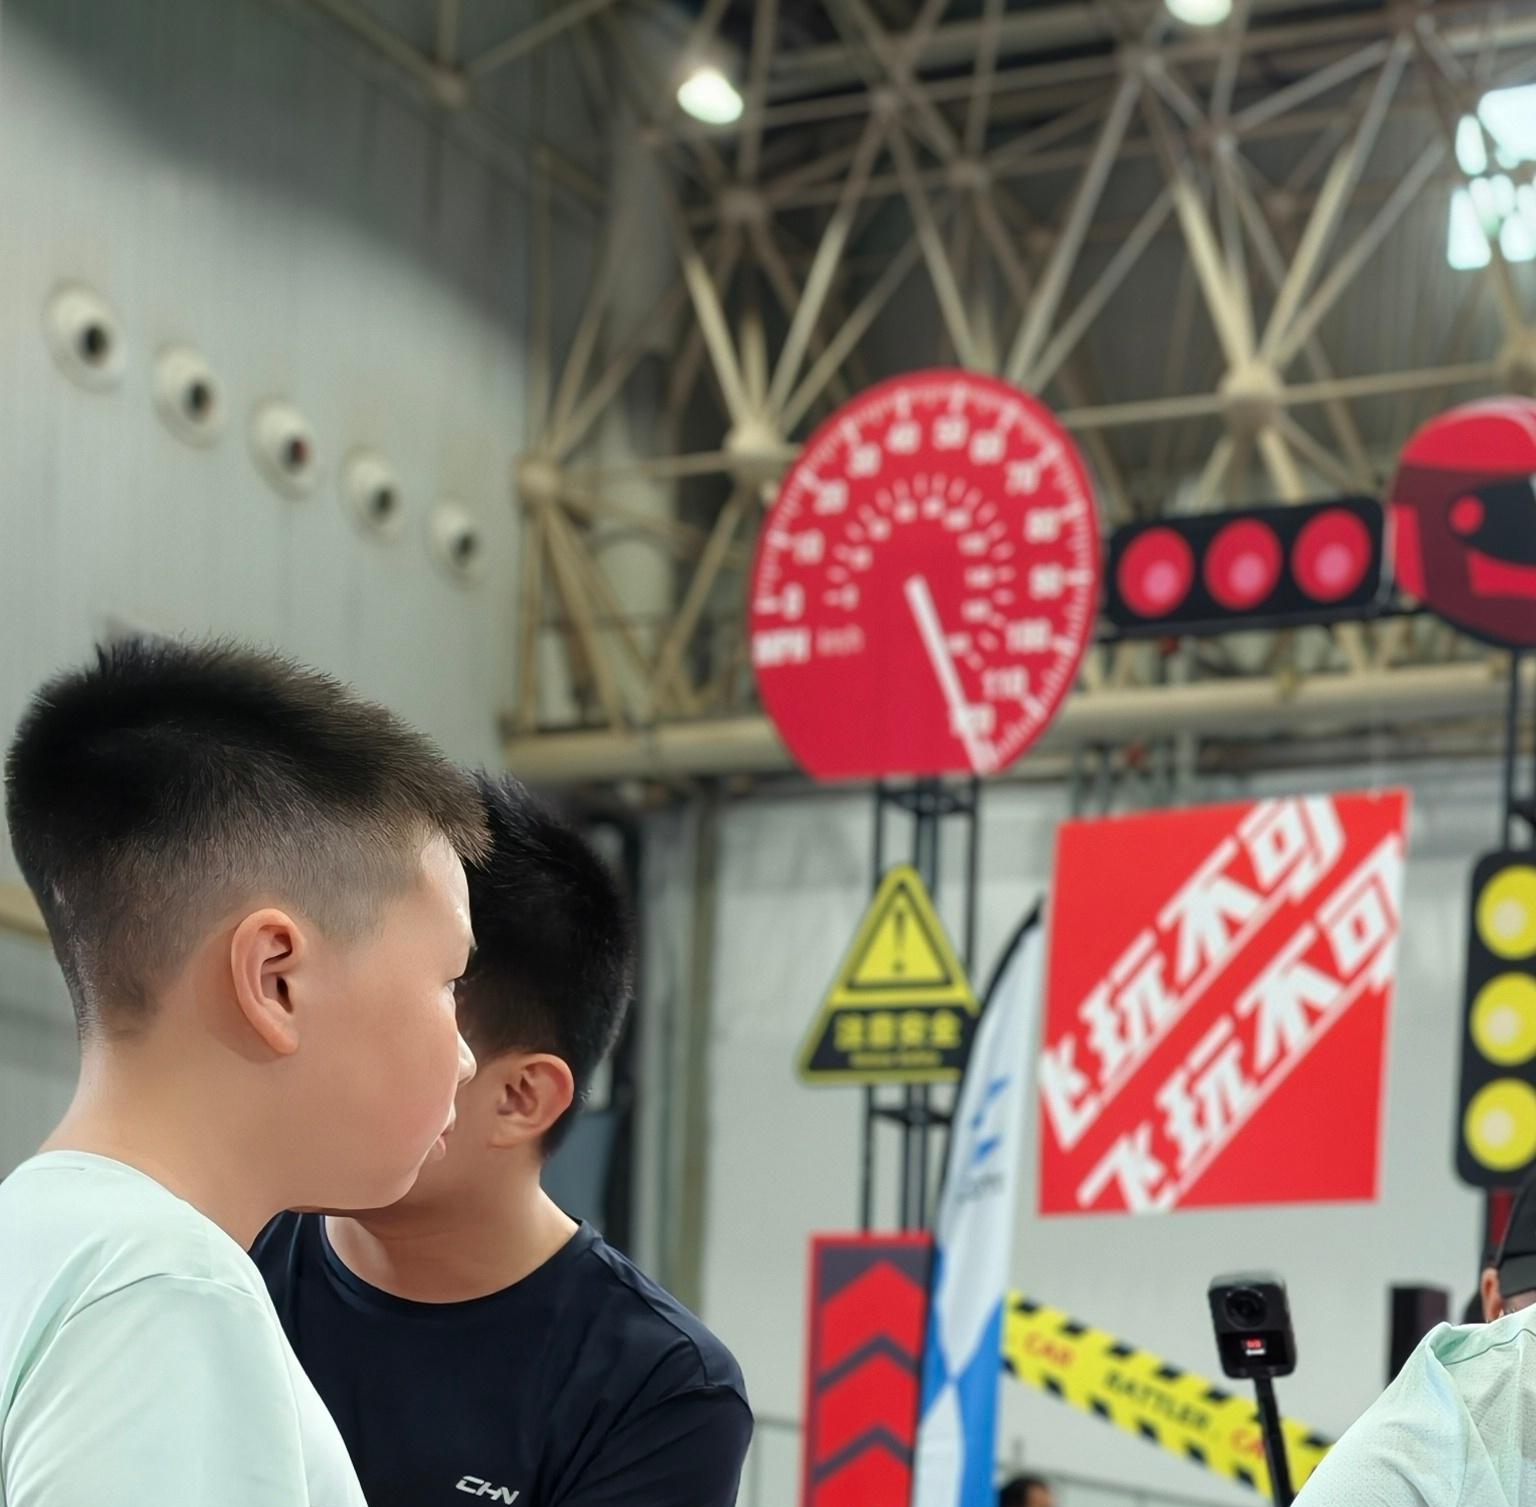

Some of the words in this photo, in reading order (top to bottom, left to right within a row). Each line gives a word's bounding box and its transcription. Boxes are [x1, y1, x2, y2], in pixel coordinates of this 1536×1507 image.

[1022, 1331, 1075, 1369] CAR
[1103, 1372, 1213, 1432] BATTLER
[1230, 1426, 1266, 1461] CA
[455, 1475, 520, 1506] CHN
